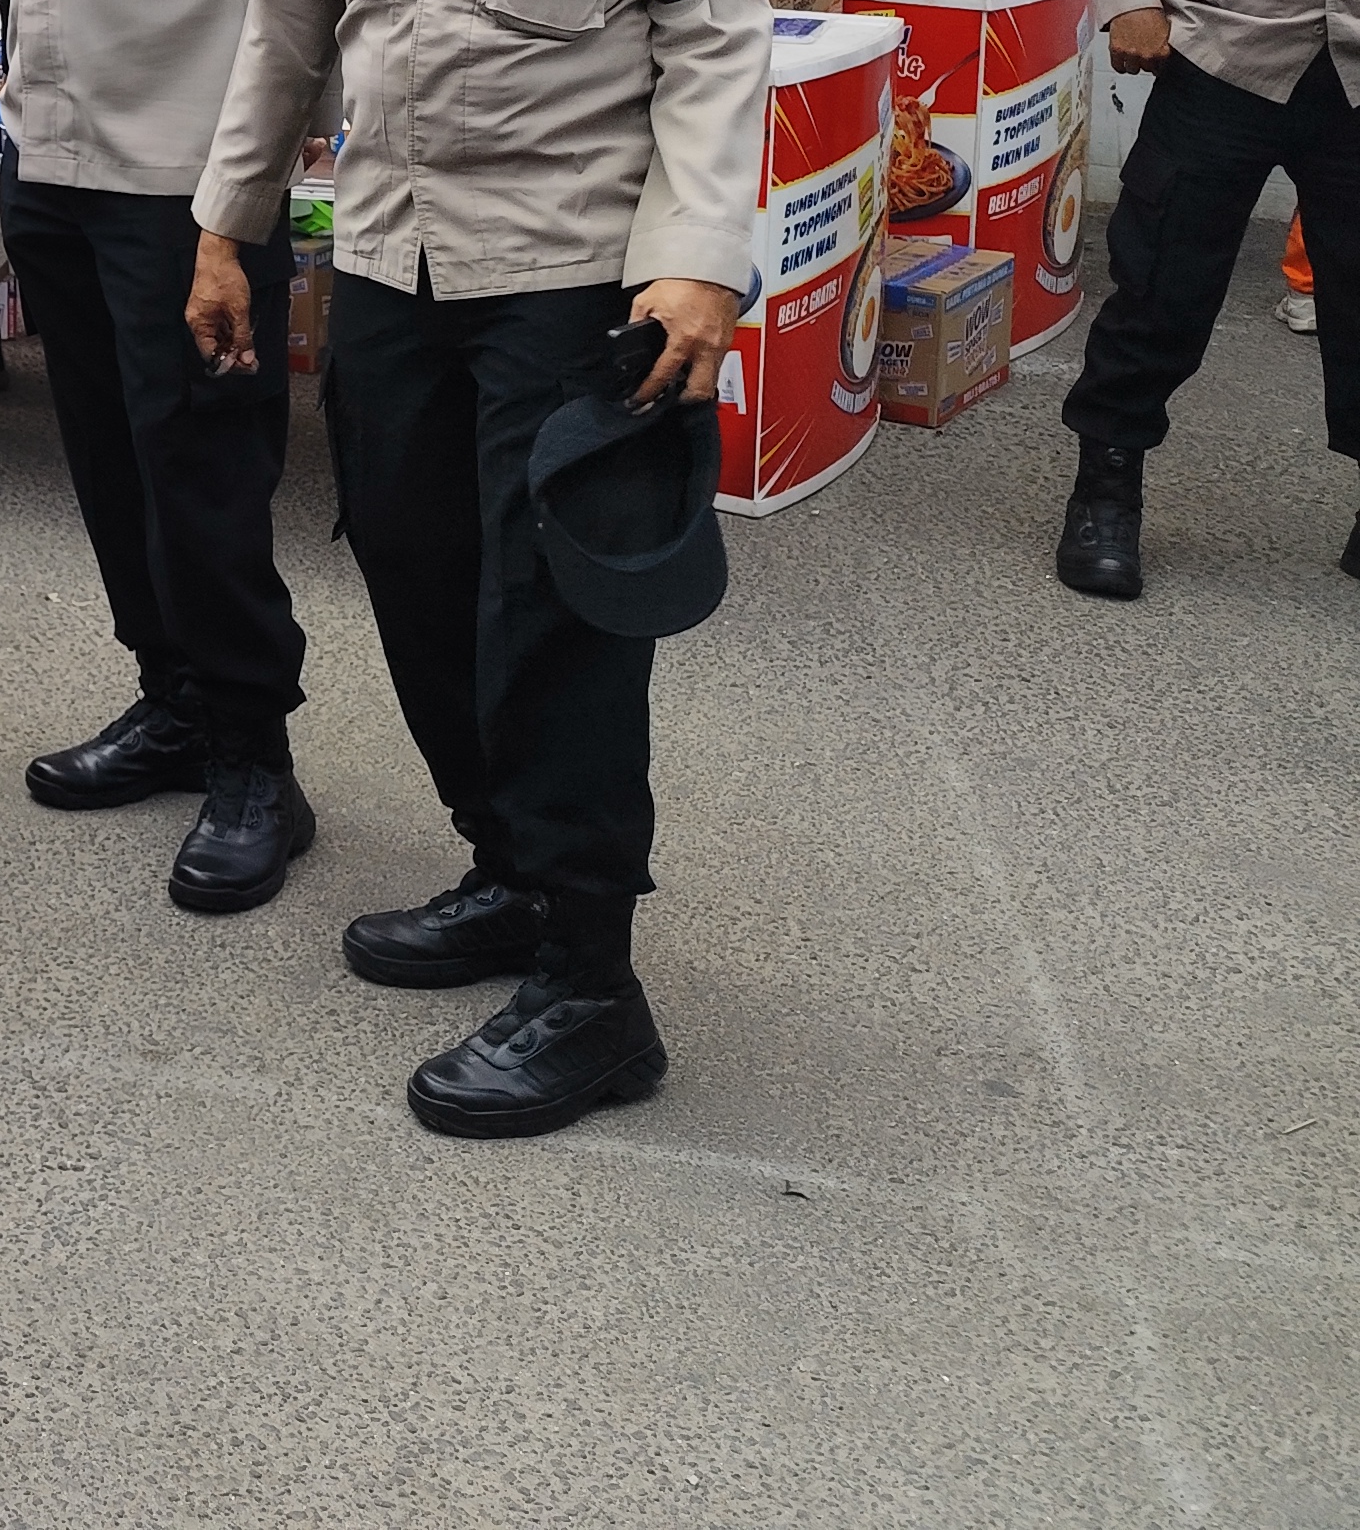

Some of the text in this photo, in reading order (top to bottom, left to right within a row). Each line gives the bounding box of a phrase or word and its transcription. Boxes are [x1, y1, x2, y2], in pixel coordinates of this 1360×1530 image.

[995, 99, 1027, 124] BUMBU
[992, 131, 1001, 146] 2
[991, 144, 1022, 171] BIKIN
[784, 189, 821, 218] BUMBU
[781, 192, 853, 246] 2 TOPPINGNYA
[780, 230, 838, 276] BIKIN WAH
[777, 299, 801, 327] BELI
[800, 295, 809, 318] 2
[880, 343, 913, 358] OW
